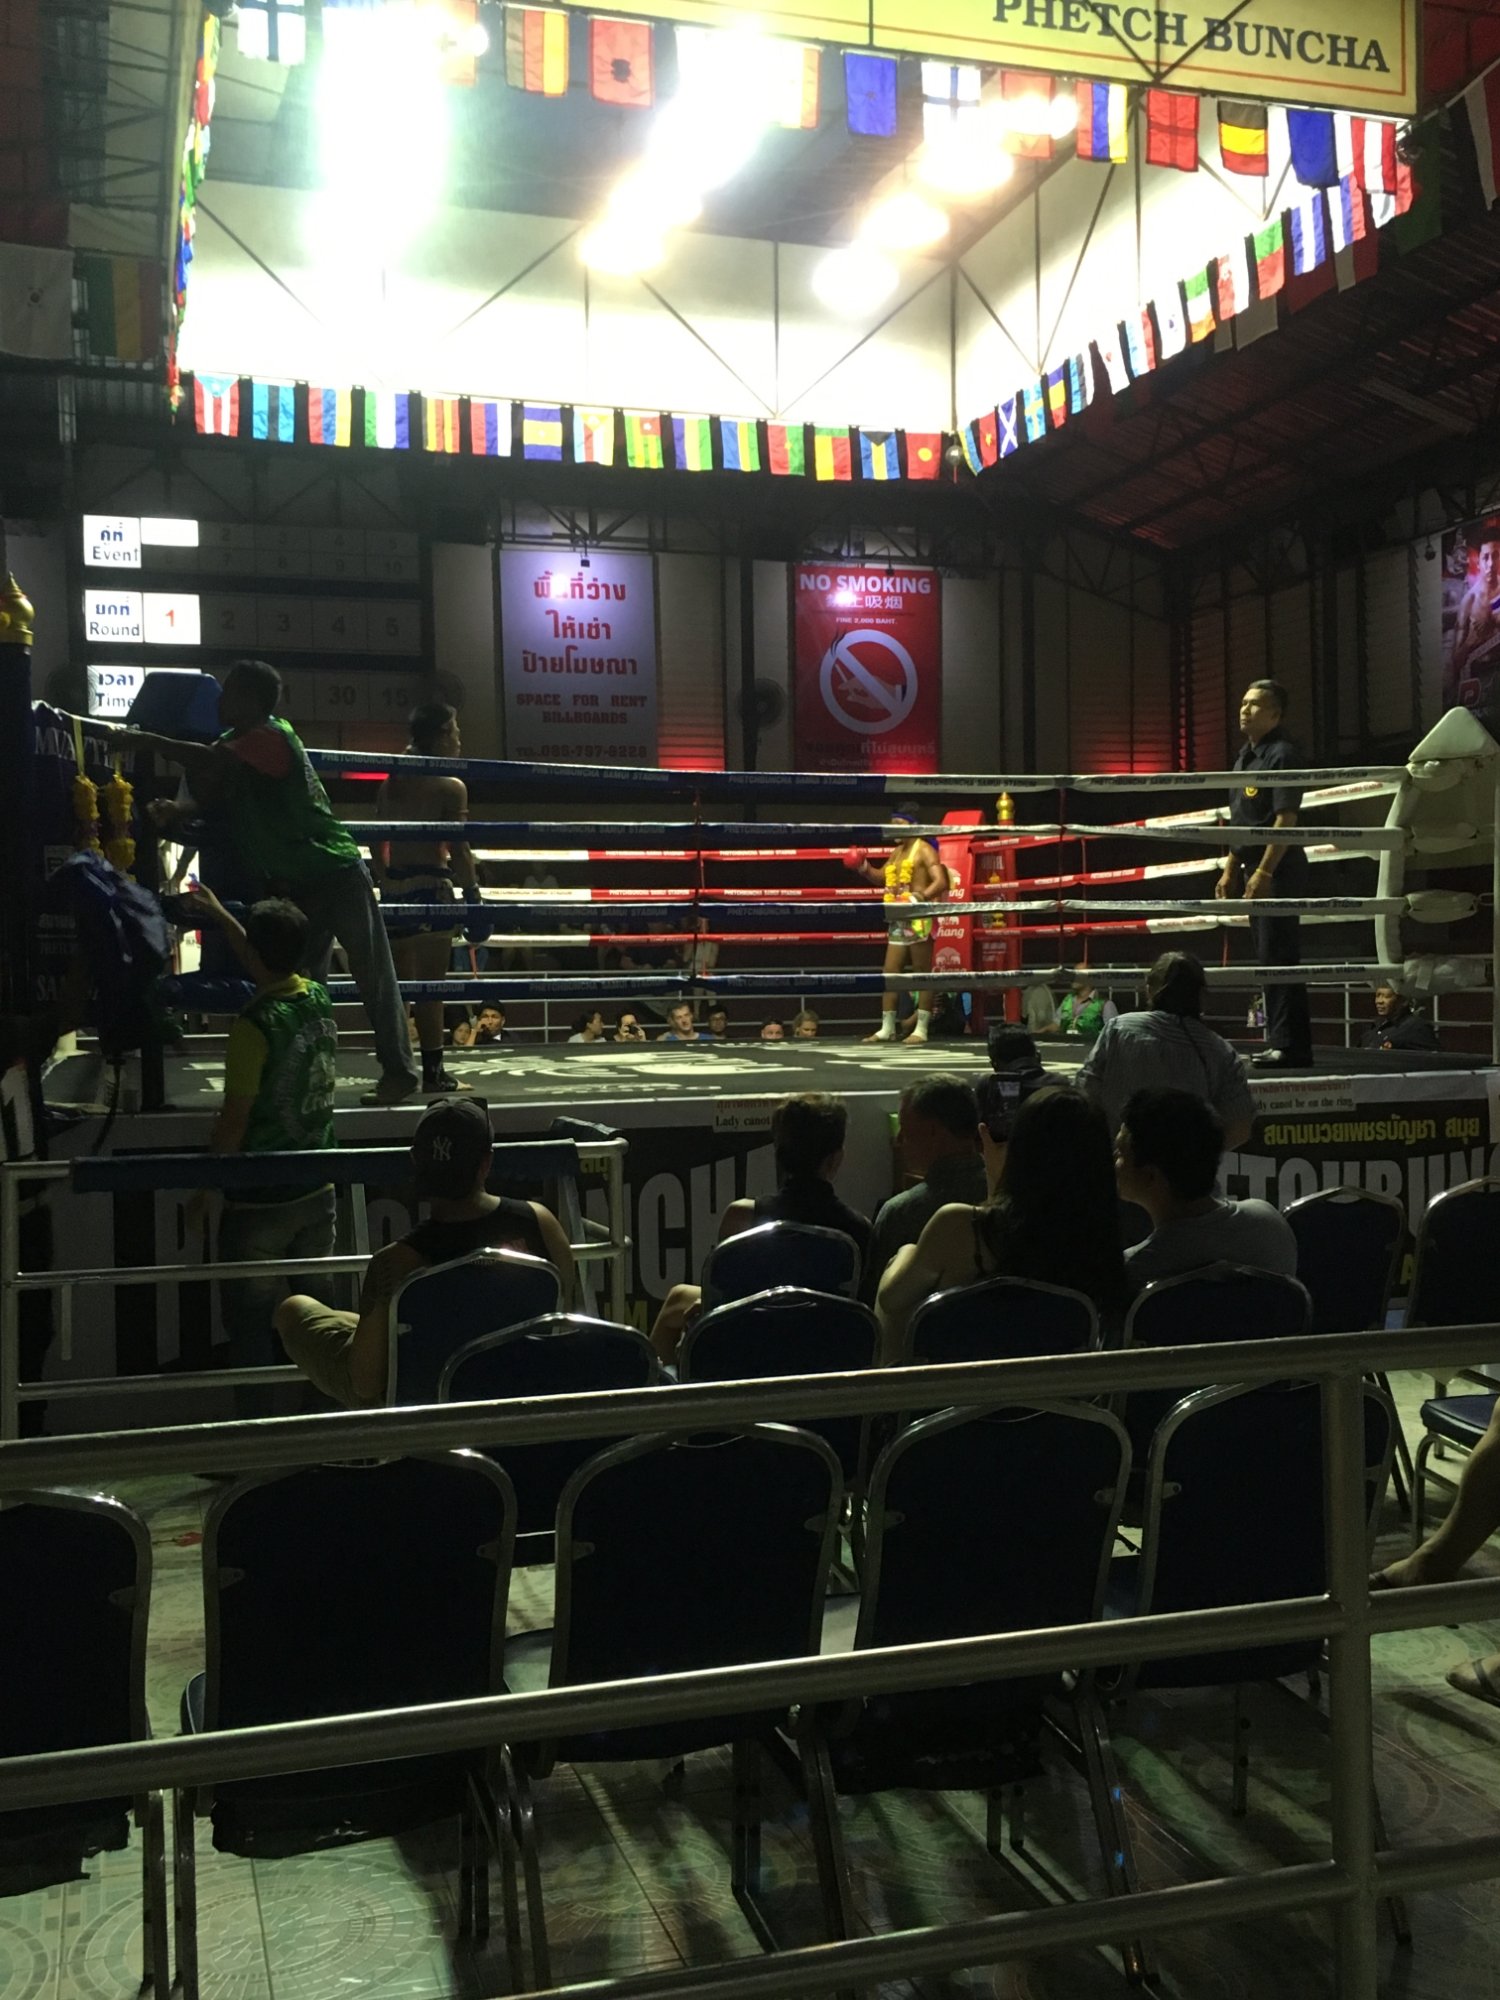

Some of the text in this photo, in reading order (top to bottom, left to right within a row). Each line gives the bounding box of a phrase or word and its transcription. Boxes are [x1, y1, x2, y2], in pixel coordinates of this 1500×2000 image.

[993, 0, 1390, 73] PHETCH BUNCHA
[92, 545, 139, 562] Event
[533, 570, 626, 602] พื้ที่ว่าง
[800, 573, 931, 594] NO SMOKING
[165, 609, 175, 627] 1
[545, 609, 612, 640] ให้เช่า
[836, 616, 853, 624] FINE
[90, 621, 140, 637] Round
[522, 644, 638, 675] ป้ายโฆษณา
[99, 673, 135, 687] เวลา
[95, 692, 135, 708] Time
[328, 686, 356, 706] 30
[516, 693, 648, 708] SPACE FOR RENT
[542, 711, 628, 724] BILLBOARDS
[937, 926, 965, 939] hang
[715, 1115, 740, 1129] Lady
[1444, 1115, 1481, 1145] สมุย
